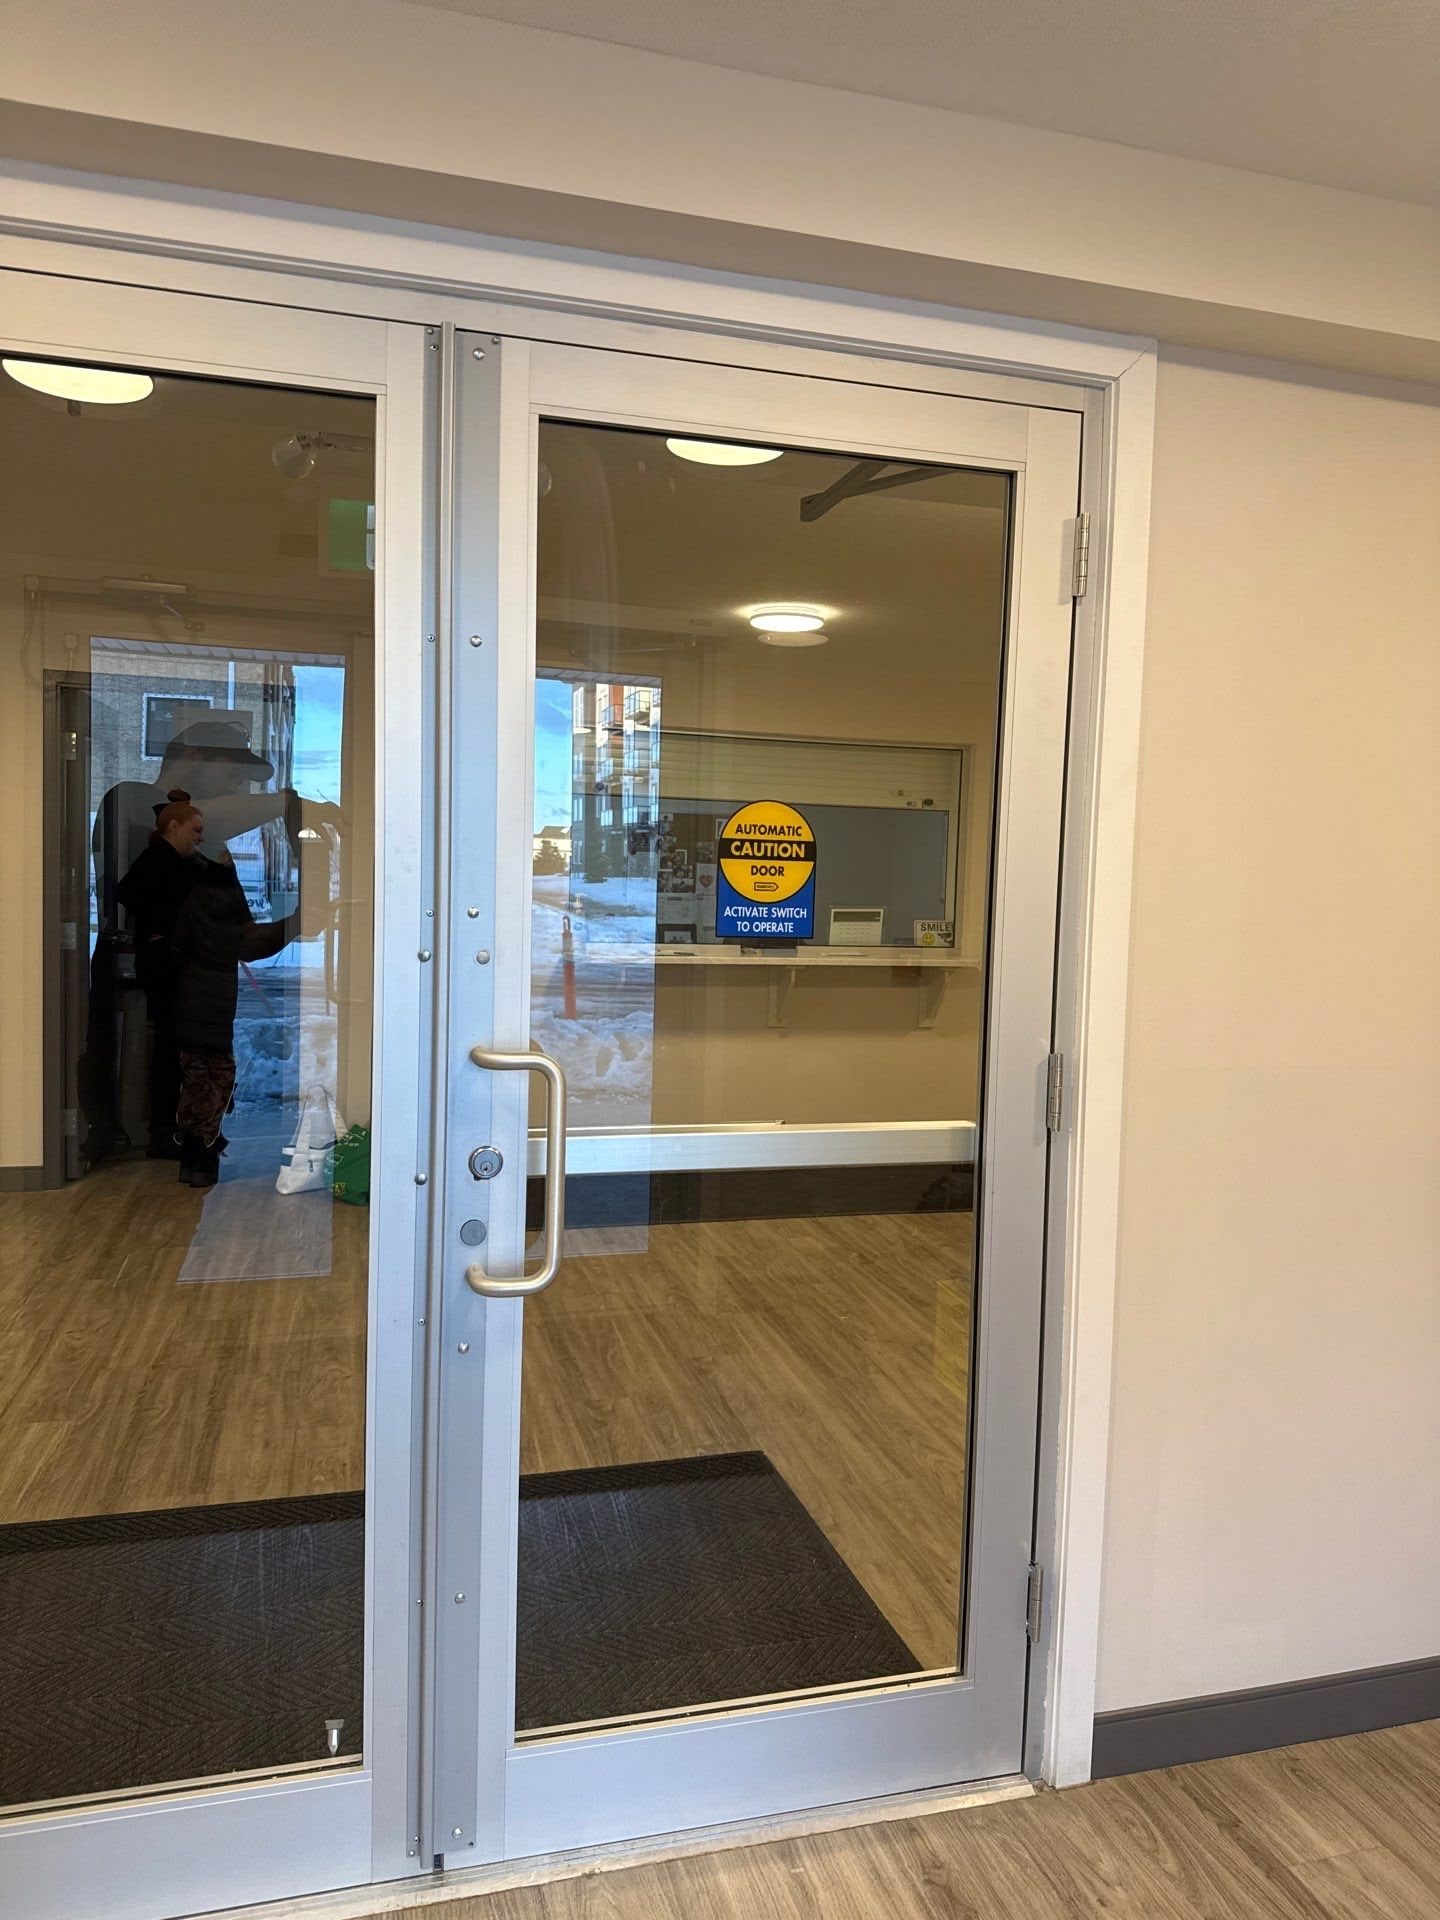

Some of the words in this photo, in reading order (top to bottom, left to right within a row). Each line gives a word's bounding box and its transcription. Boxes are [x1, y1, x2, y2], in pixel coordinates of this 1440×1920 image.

[735, 823, 803, 837] AUTOMATIC
[730, 841, 805, 858] CAUTION
[750, 865, 785, 877] DOOR
[723, 906, 769, 918] ACTIVATE
[770, 908, 807, 919] SWITCH
[736, 921, 750, 932] TO
[752, 921, 794, 933] OPERATE
[920, 922, 952, 932] SMILE
